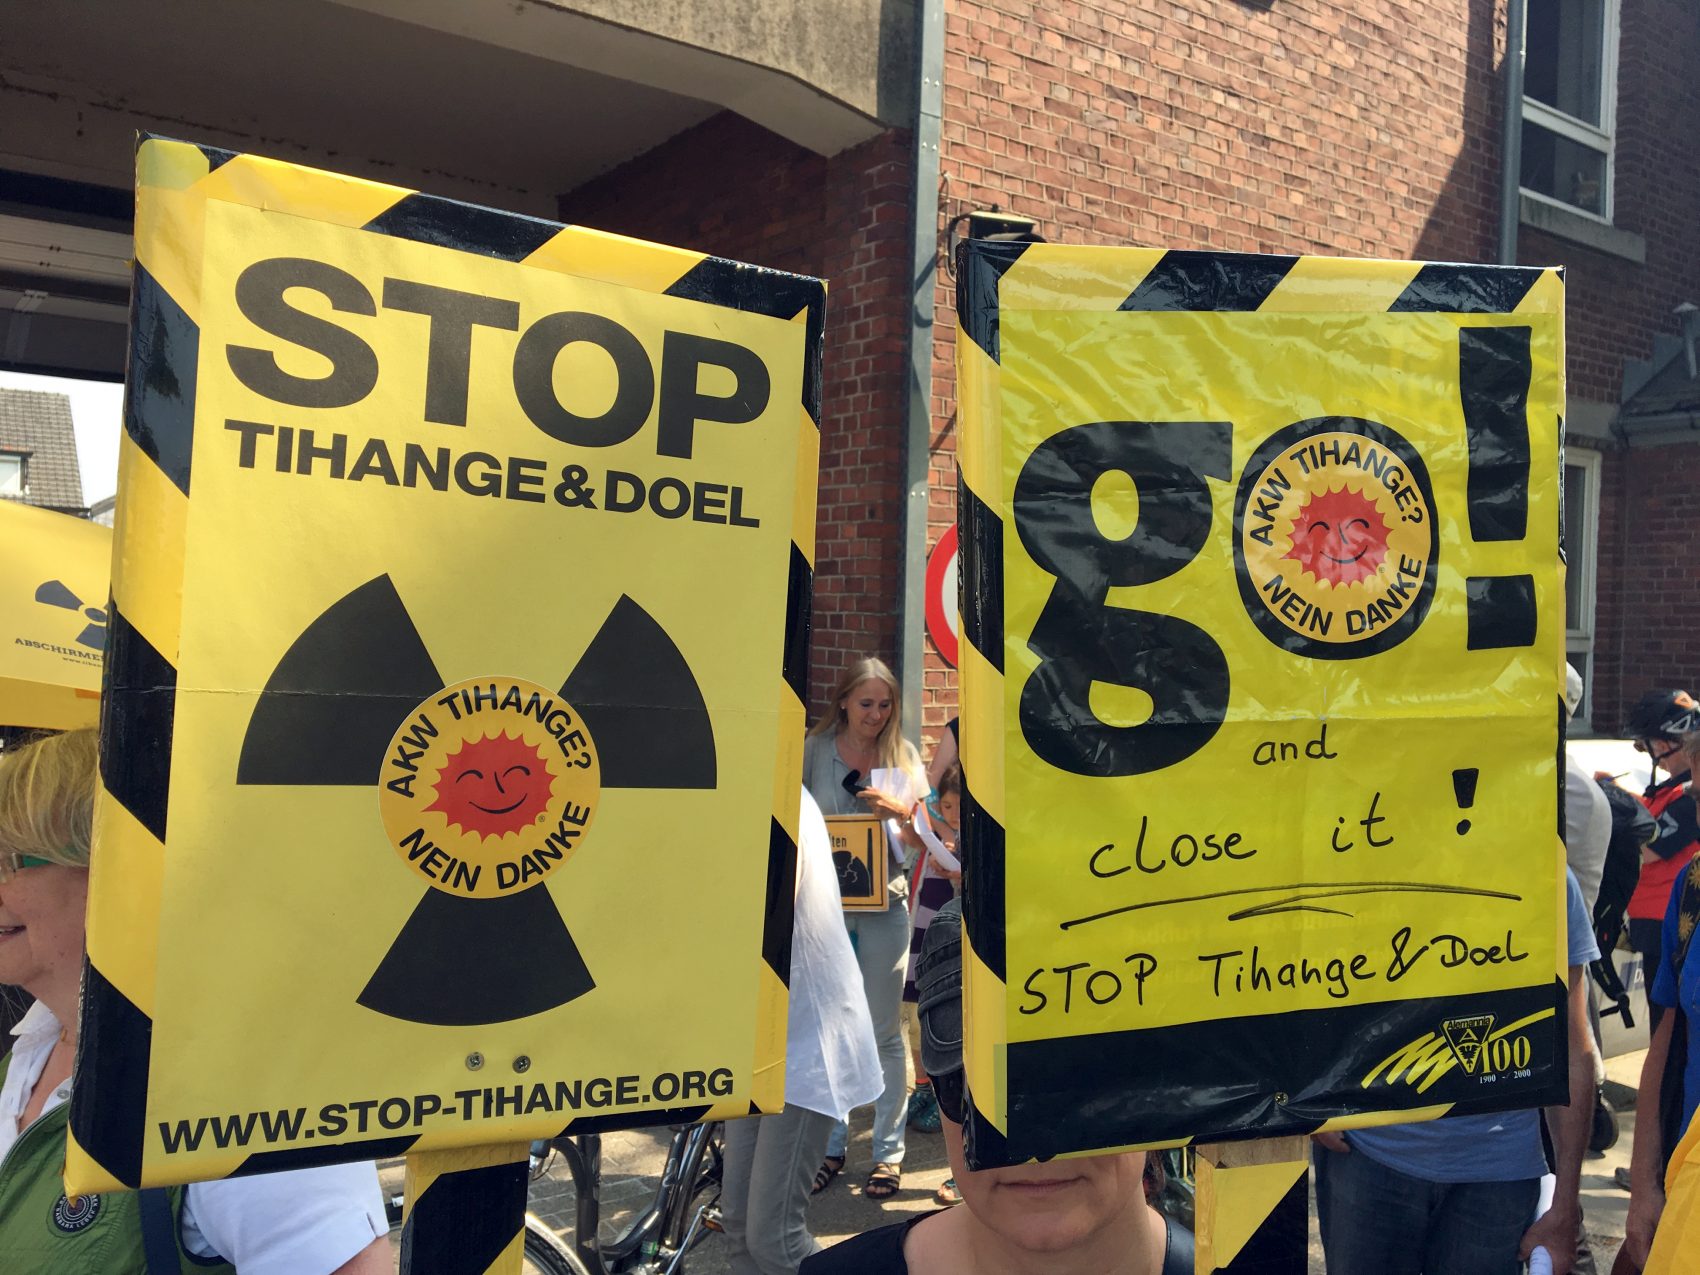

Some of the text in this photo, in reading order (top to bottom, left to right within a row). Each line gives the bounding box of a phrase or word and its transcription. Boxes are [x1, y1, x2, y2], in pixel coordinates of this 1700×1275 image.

[225, 257, 771, 460] STOP
[1249, 439, 1423, 546] AKW TIHANGE?
[1262, 553, 1422, 636] NEIN DANKE
[387, 683, 592, 798] AKW TIHANGE?
[1252, 724, 1338, 766] and
[399, 801, 590, 892] NEIN DANKE
[1089, 767, 1480, 878] close it !
[1019, 953, 1158, 1015] STOP
[1448, 1017, 1491, 1030] Alemannia
[1479, 1074, 1496, 1084] 1900
[1513, 1068, 1531, 1079] 2000
[1480, 1035, 1531, 1074] 100
[158, 1067, 734, 1155] WWW.STOP-TIHANGE.ORG
